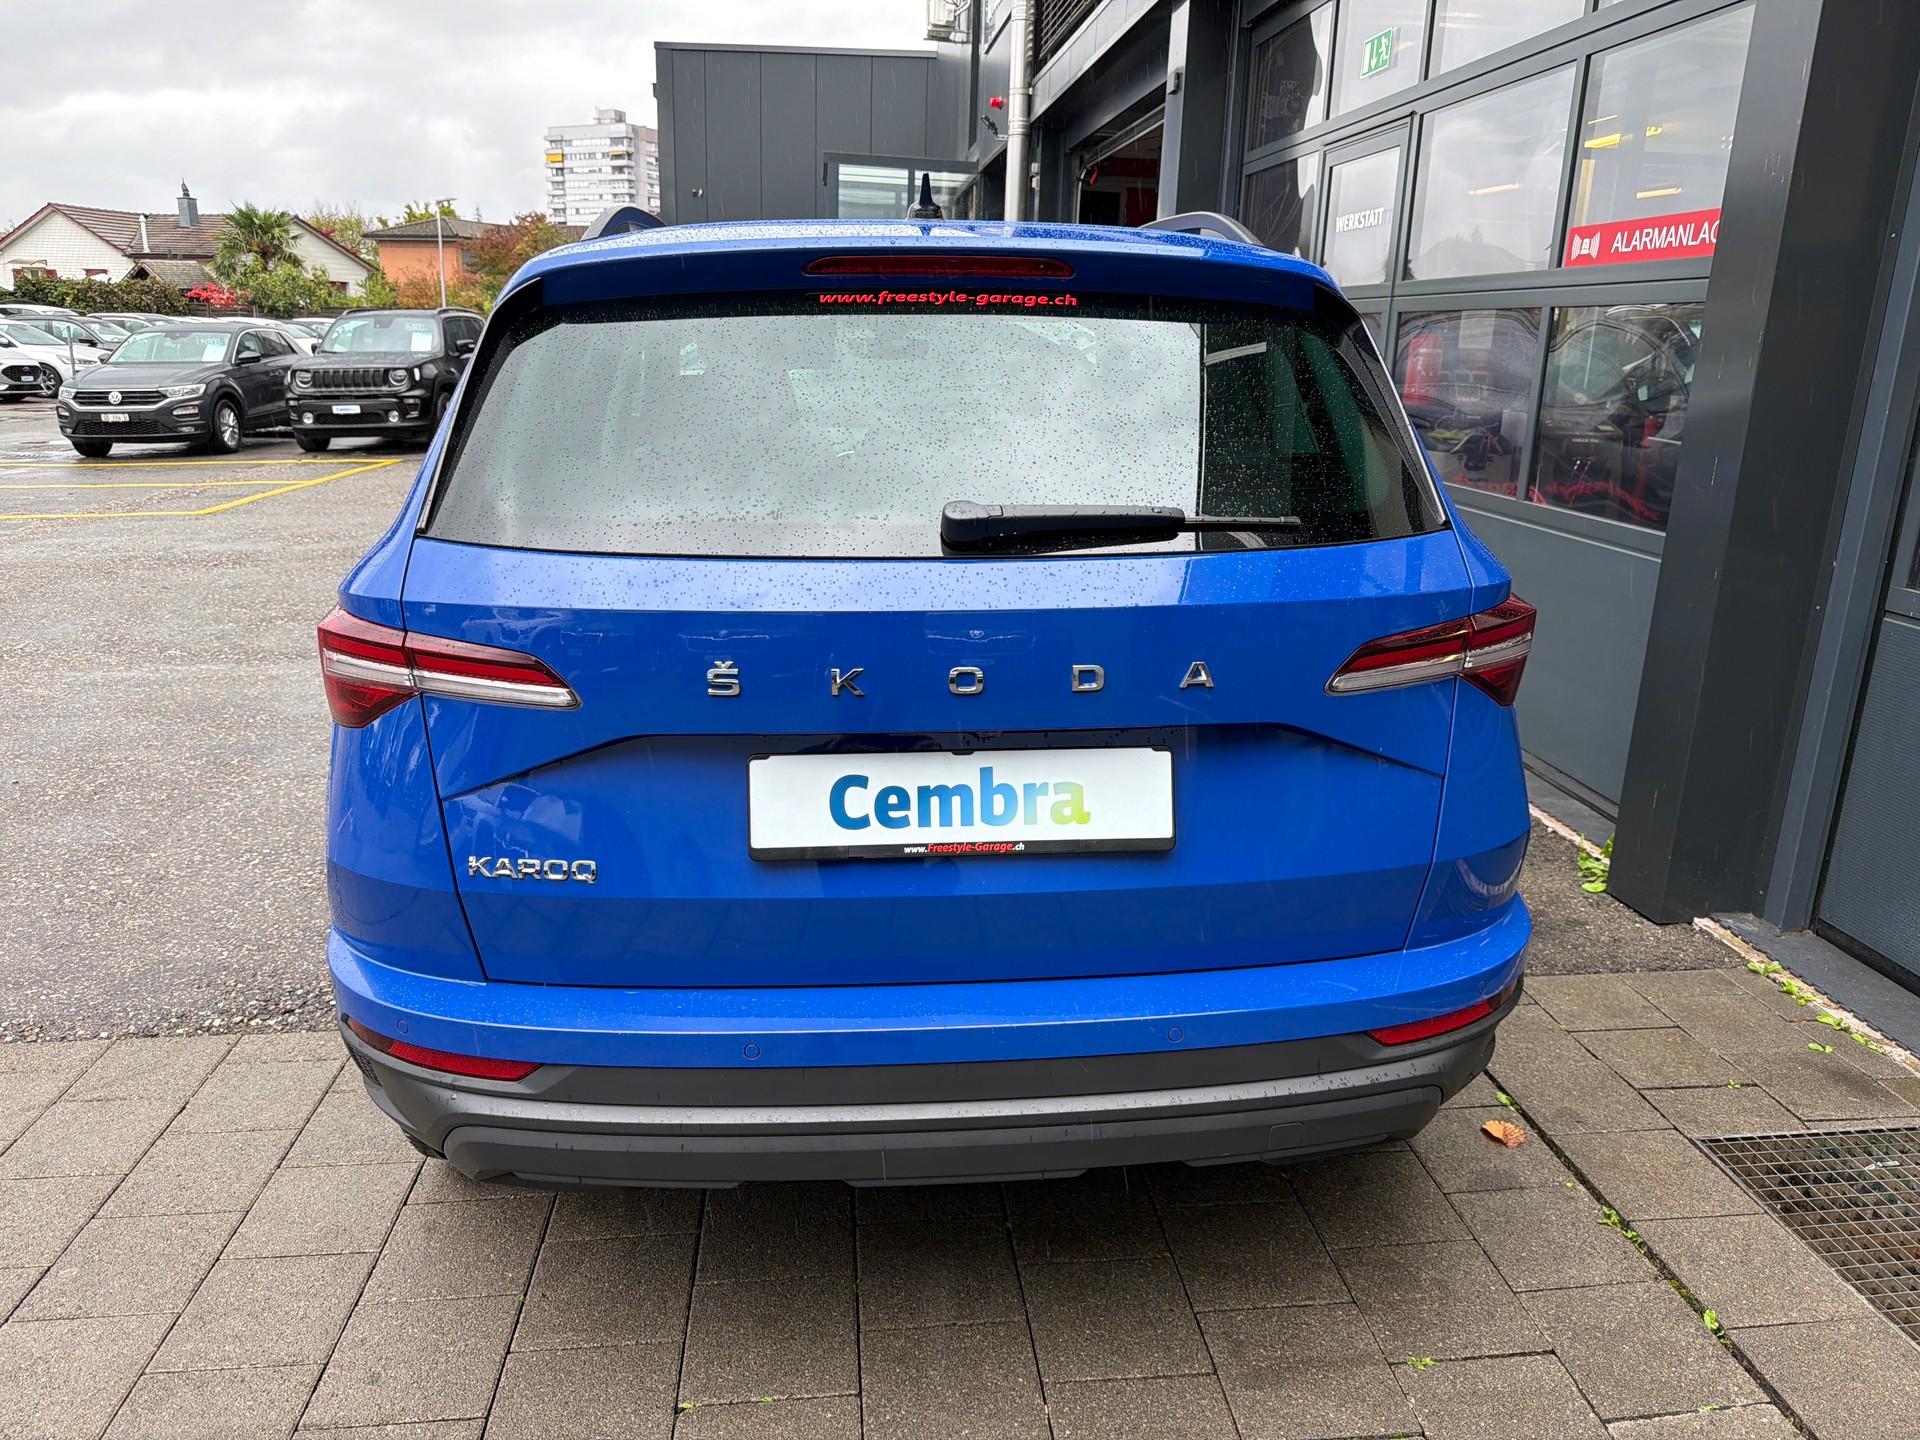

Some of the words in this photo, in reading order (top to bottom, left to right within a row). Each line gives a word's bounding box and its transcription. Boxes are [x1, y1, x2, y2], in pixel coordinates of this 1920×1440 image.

[1335, 207, 1385, 233] WERKSTATT
[819, 291, 1078, 307] www.freestyle-garage.ch
[706, 660, 1215, 697] ŠKODA
[828, 766, 1091, 831] Cembra
[903, 841, 1026, 854] www.Freestyle-Garage.ch
[468, 855, 598, 885] KAROQ
